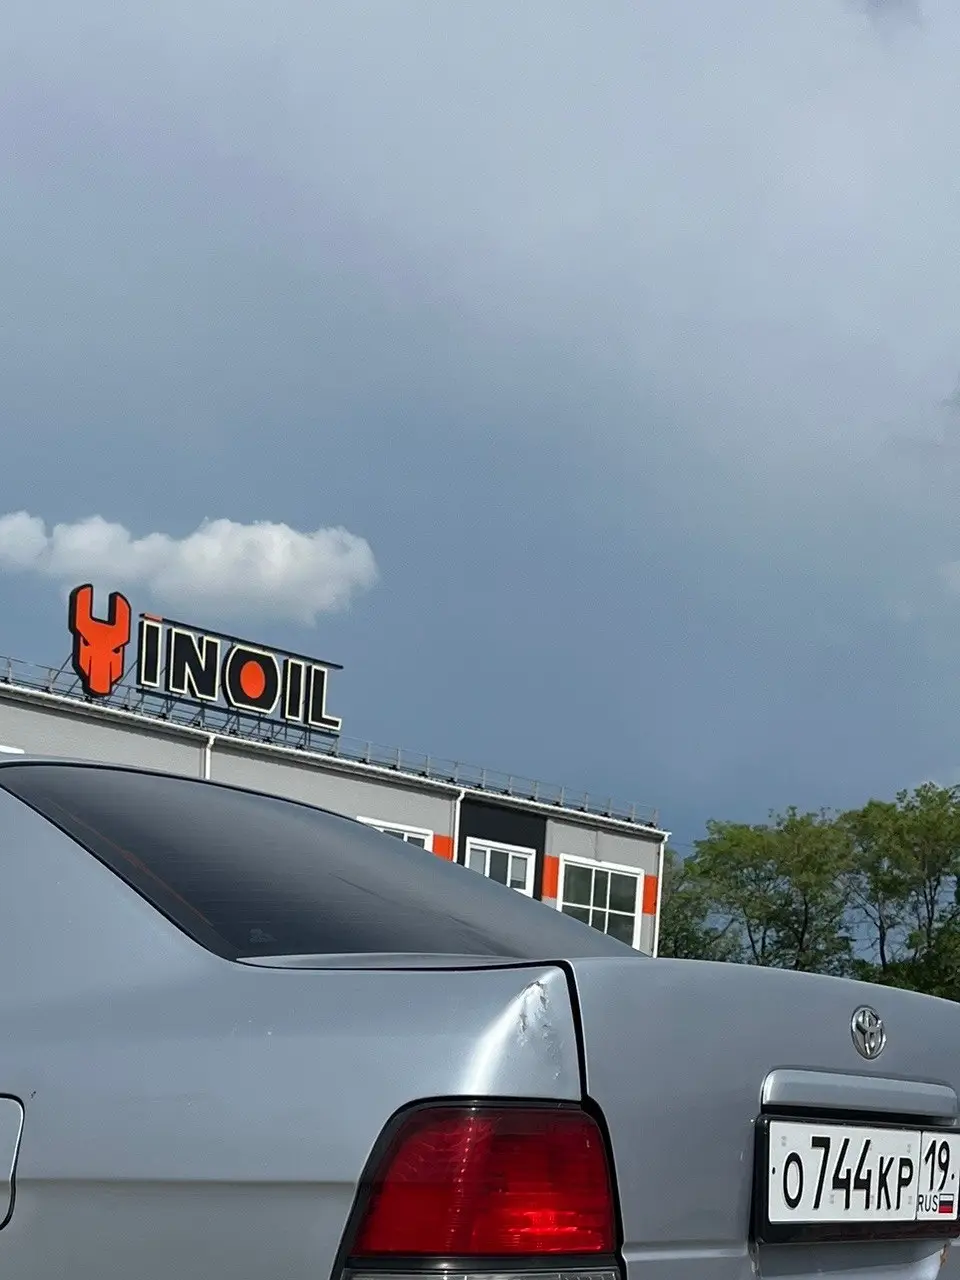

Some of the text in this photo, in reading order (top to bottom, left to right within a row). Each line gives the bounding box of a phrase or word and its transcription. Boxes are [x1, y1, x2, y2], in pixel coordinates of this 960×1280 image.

[137, 619, 342, 731] INOIL
[924, 1139, 951, 1192] 19
[917, 1194, 939, 1212] RUS
